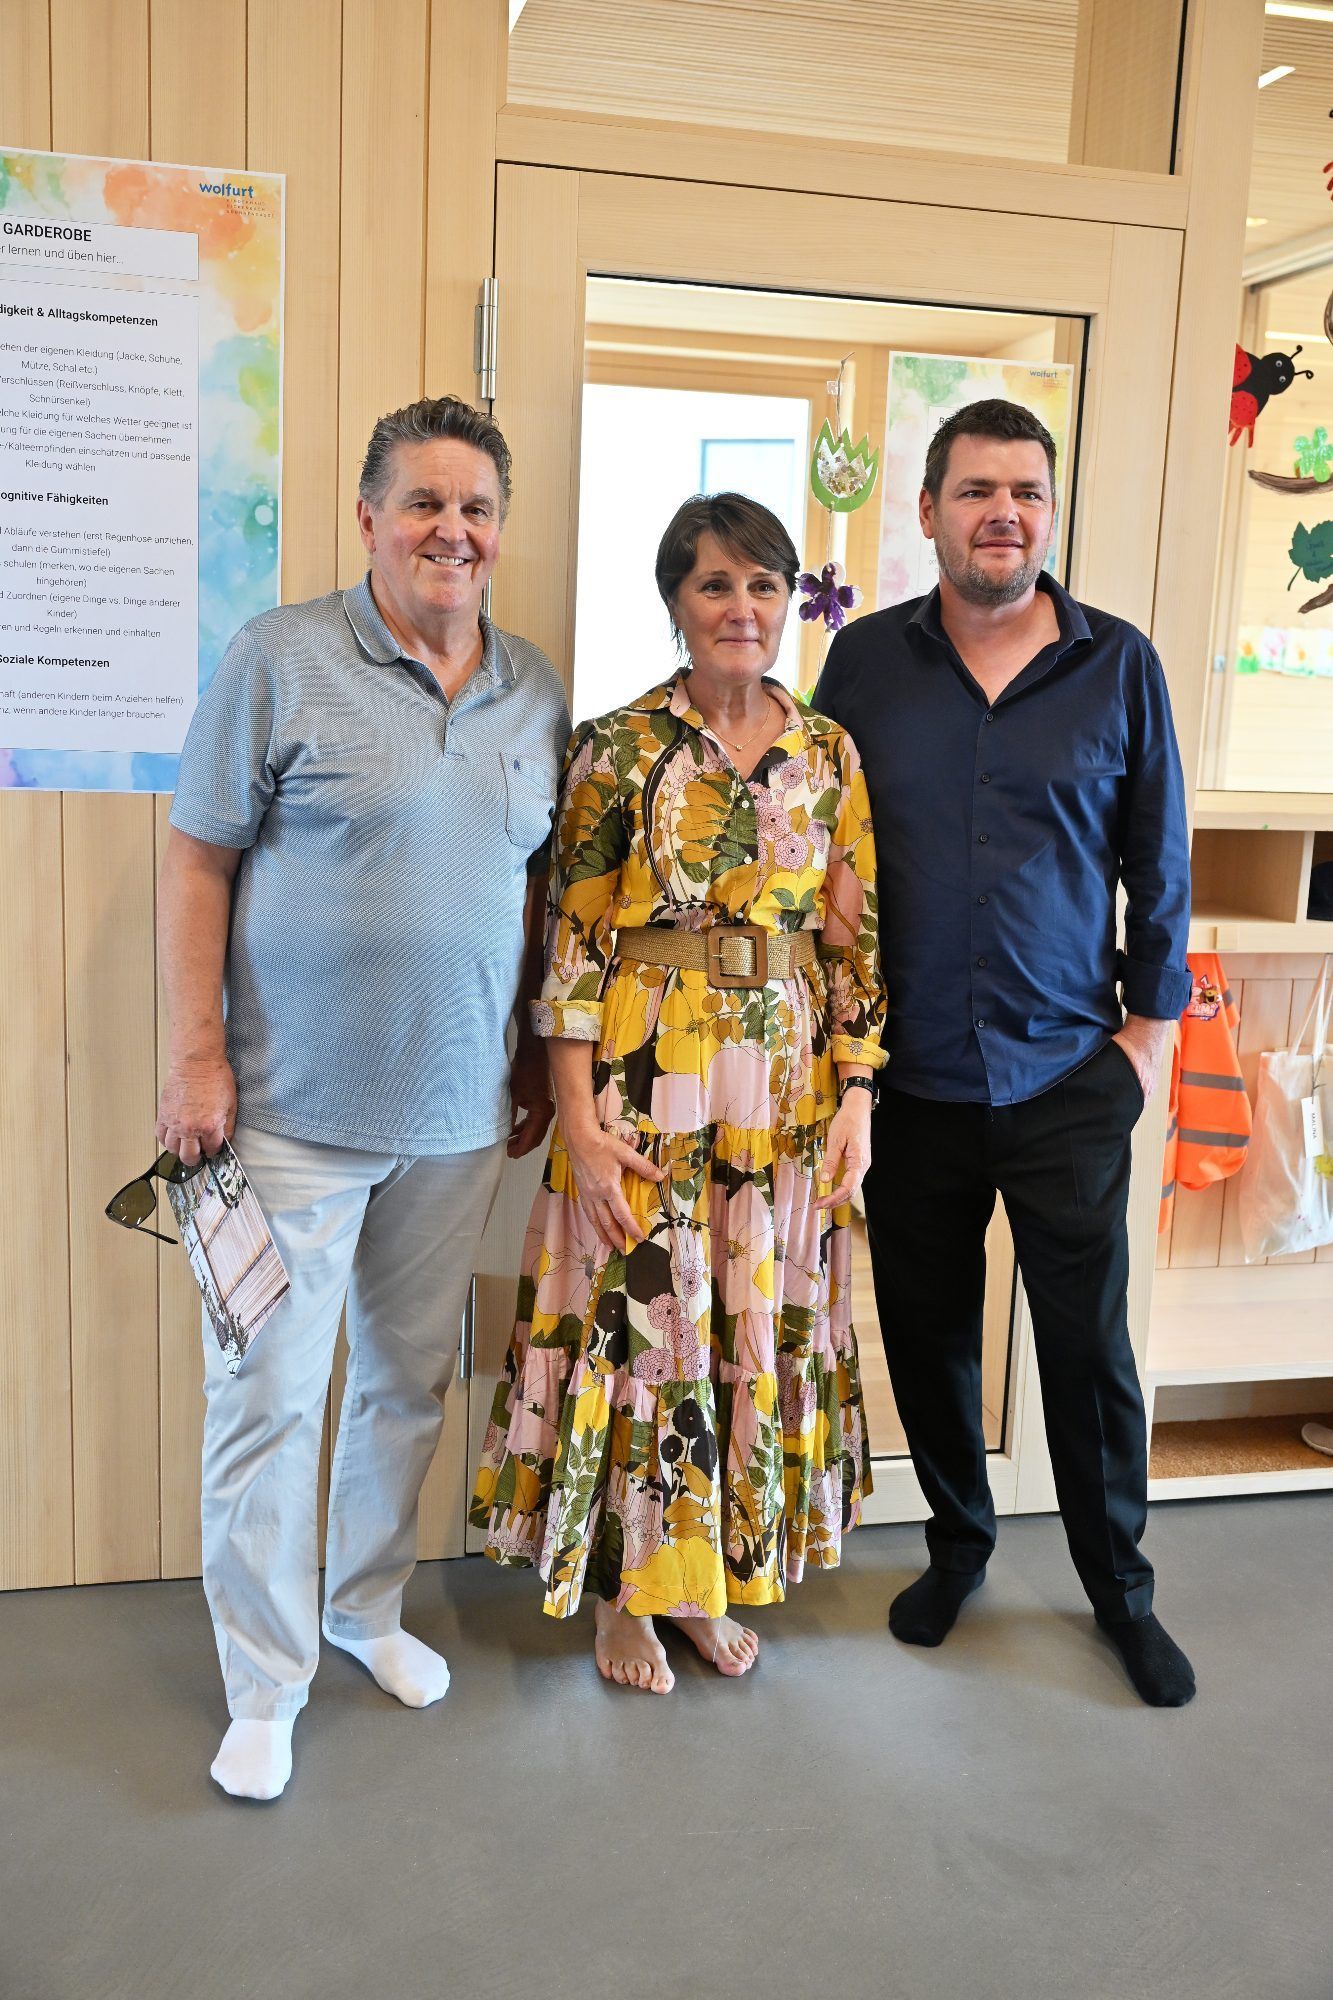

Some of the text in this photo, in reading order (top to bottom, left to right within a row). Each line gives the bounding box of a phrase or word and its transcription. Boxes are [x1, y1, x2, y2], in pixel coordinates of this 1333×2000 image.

[199, 183, 254, 198] wolfurt
[3, 222, 92, 242] GARDEROBE
[9, 244, 41, 256] lernen
[45, 246, 64, 259] und
[67, 248, 94, 262] üben
[97, 251, 124, 264] hier...
[37, 307, 44, 316] &
[48, 308, 158, 326] Alltagskompetenzen
[24, 344, 38, 353] der
[41, 346, 74, 357] eigenen
[77, 348, 114, 360] Kleidung
[117, 351, 146, 362] (Jacke,
[149, 354, 182, 365] Schuhe,
[22, 361, 98, 375] Mütze, Schal etc.)
[0, 376, 53, 388] erschlüssen
[129, 385, 161, 396] Knöpfe,
[30, 394, 91, 407] Schnürsenkel)
[22, 411, 60, 422] Kleidung
[62, 412, 73, 422] für
[76, 413, 110, 424] welches
[113, 417, 141, 427] Wetter
[144, 418, 180, 430] geeignet
[182, 421, 192, 430] ist
[20, 426, 31, 435] für
[34, 428, 46, 436] die
[49, 429, 82, 438] eigenen
[85, 431, 116, 441] Sachen
[119, 432, 172, 444] übernehmen
[132, 451, 147, 459] und
[151, 452, 190, 462] passende
[26, 459, 63, 471] Kleidung
[47, 492, 109, 506] Fähigkeiten
[4, 527, 36, 537] Abläufe
[40, 530, 80, 539] verstehen
[84, 531, 102, 540] (erst
[106, 532, 152, 543] Regenhose
[12, 544, 111, 558] dann die Gummistiefel)
[4, 560, 36, 569] schulen
[40, 561, 77, 571] (merken,
[94, 564, 106, 572] die
[109, 565, 141, 575] eigenen
[144, 567, 175, 576] Sachen
[7, 591, 47, 600] Zuordnen
[50, 593, 81, 603] (eigene
[83, 595, 107, 605] Dinge
[124, 597, 147, 607] Dinge
[149, 598, 181, 607] anderer
[47, 609, 78, 619] Kinder)
[15, 623, 30, 631] und
[34, 624, 62, 634] Regeln
[65, 625, 102, 635] erkennen
[106, 628, 121, 636] und
[123, 628, 161, 638] einhalten
[38, 656, 110, 668] Kompetenzen
[18, 690, 56, 700] (anderen
[58, 692, 89, 701] Kindern
[92, 693, 112, 702] beim
[115, 694, 152, 703] Anziehen
[156, 695, 184, 706] helfen)
[14, 707, 36, 715] wenn
[39, 707, 67, 716] andere
[70, 708, 96, 717] Kinder
[127, 710, 165, 719] brauchen
